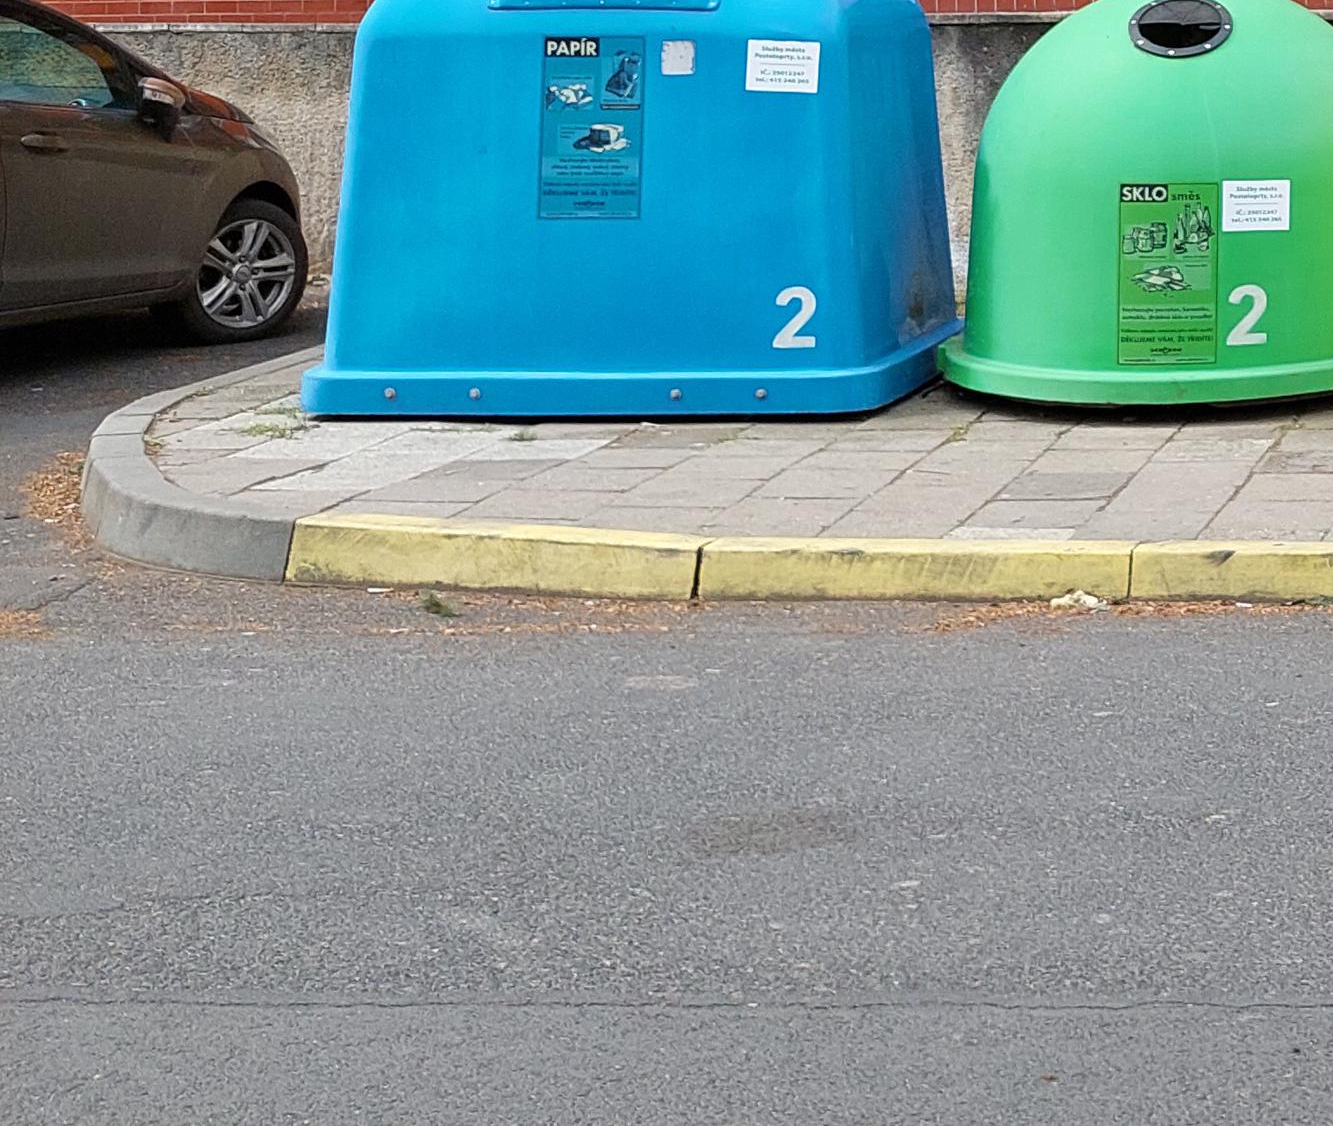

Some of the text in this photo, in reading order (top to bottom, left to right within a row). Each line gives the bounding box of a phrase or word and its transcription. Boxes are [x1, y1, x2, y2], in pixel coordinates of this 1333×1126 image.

[546, 37, 598, 56] PAPÍR
[1122, 186, 1167, 202] SKLO
[772, 285, 818, 350] 2
[1225, 283, 1269, 347] 2
